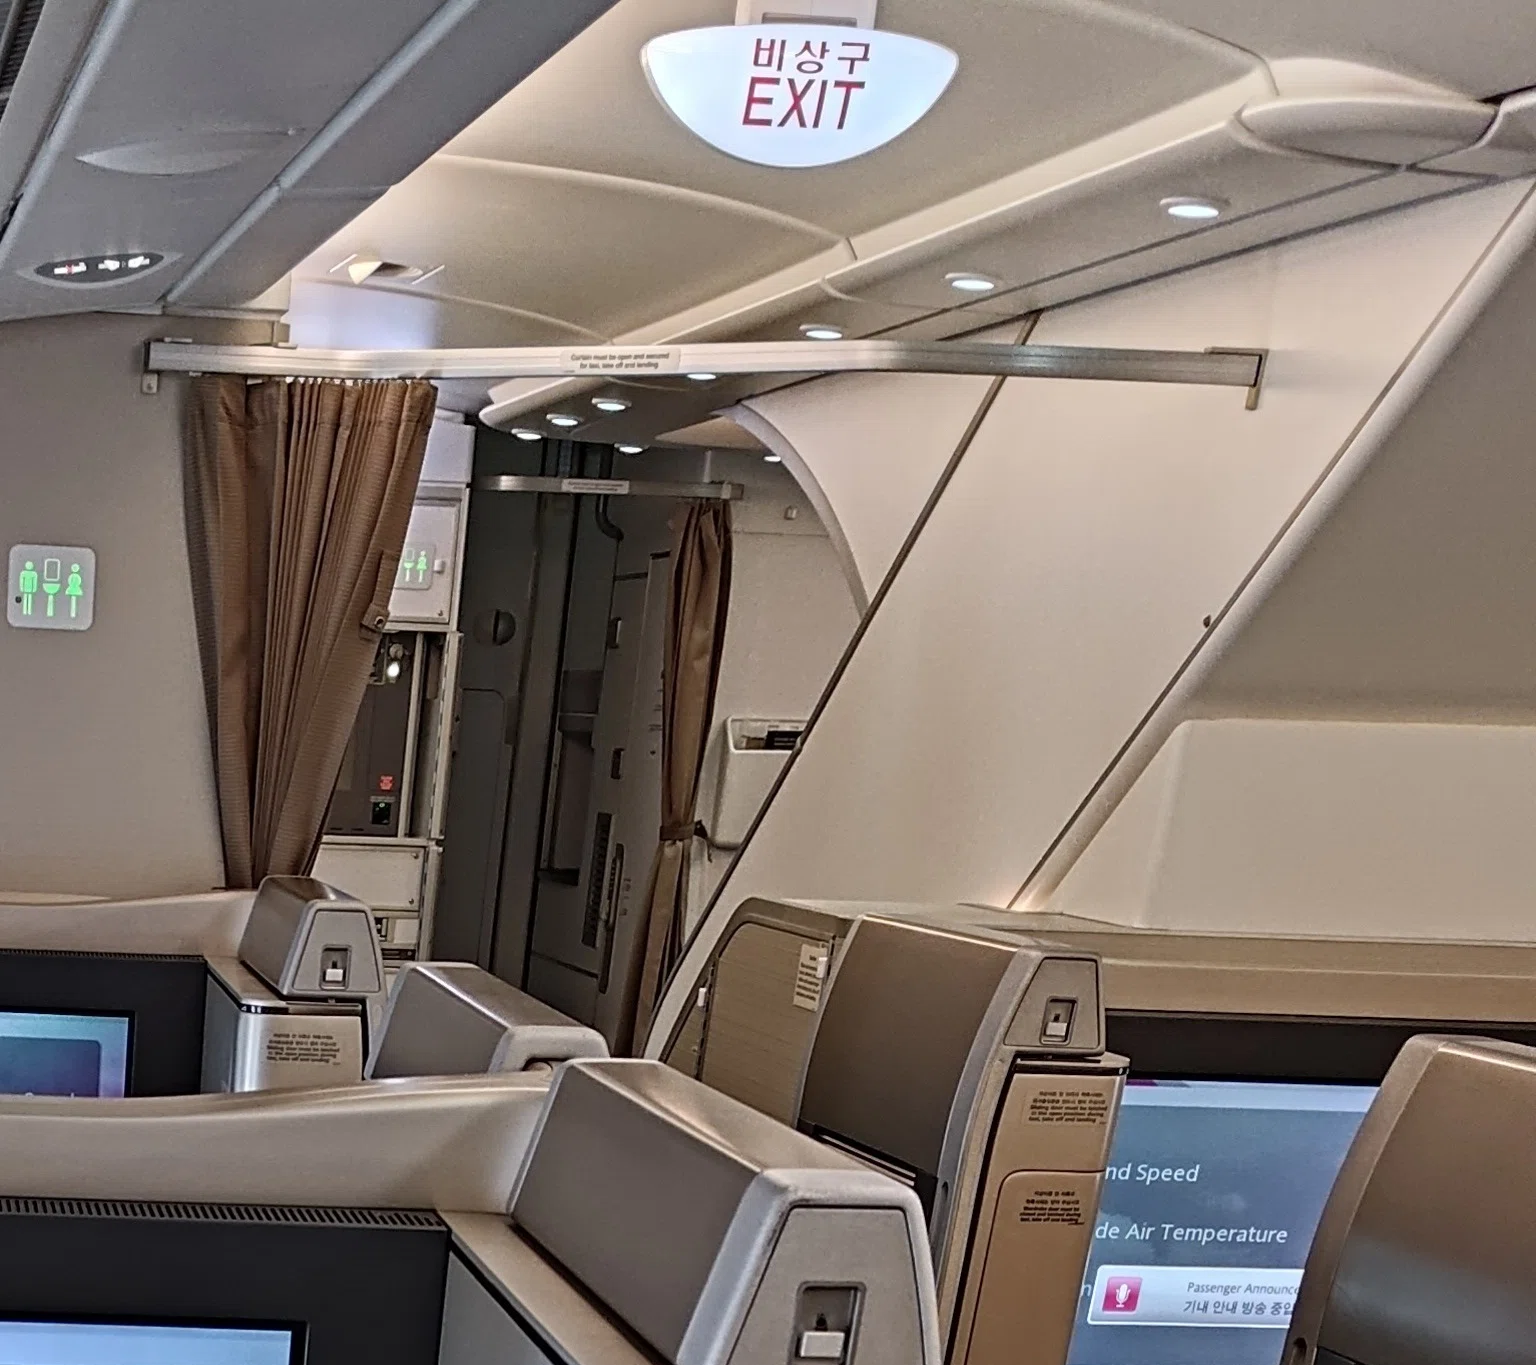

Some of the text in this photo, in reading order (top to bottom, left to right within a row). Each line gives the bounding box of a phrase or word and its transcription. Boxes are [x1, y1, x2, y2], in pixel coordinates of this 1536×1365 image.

[753, 38, 870, 74] 비상구
[742, 76, 866, 130] EXIT
[1136, 1164, 1201, 1185] Speed
[1125, 1222, 1156, 1241] Air
[1161, 1223, 1289, 1245] Temperature
[1187, 1282, 1241, 1296] Passenger
[1183, 1300, 1209, 1314] 기내
[1213, 1301, 1238, 1314] 안내
